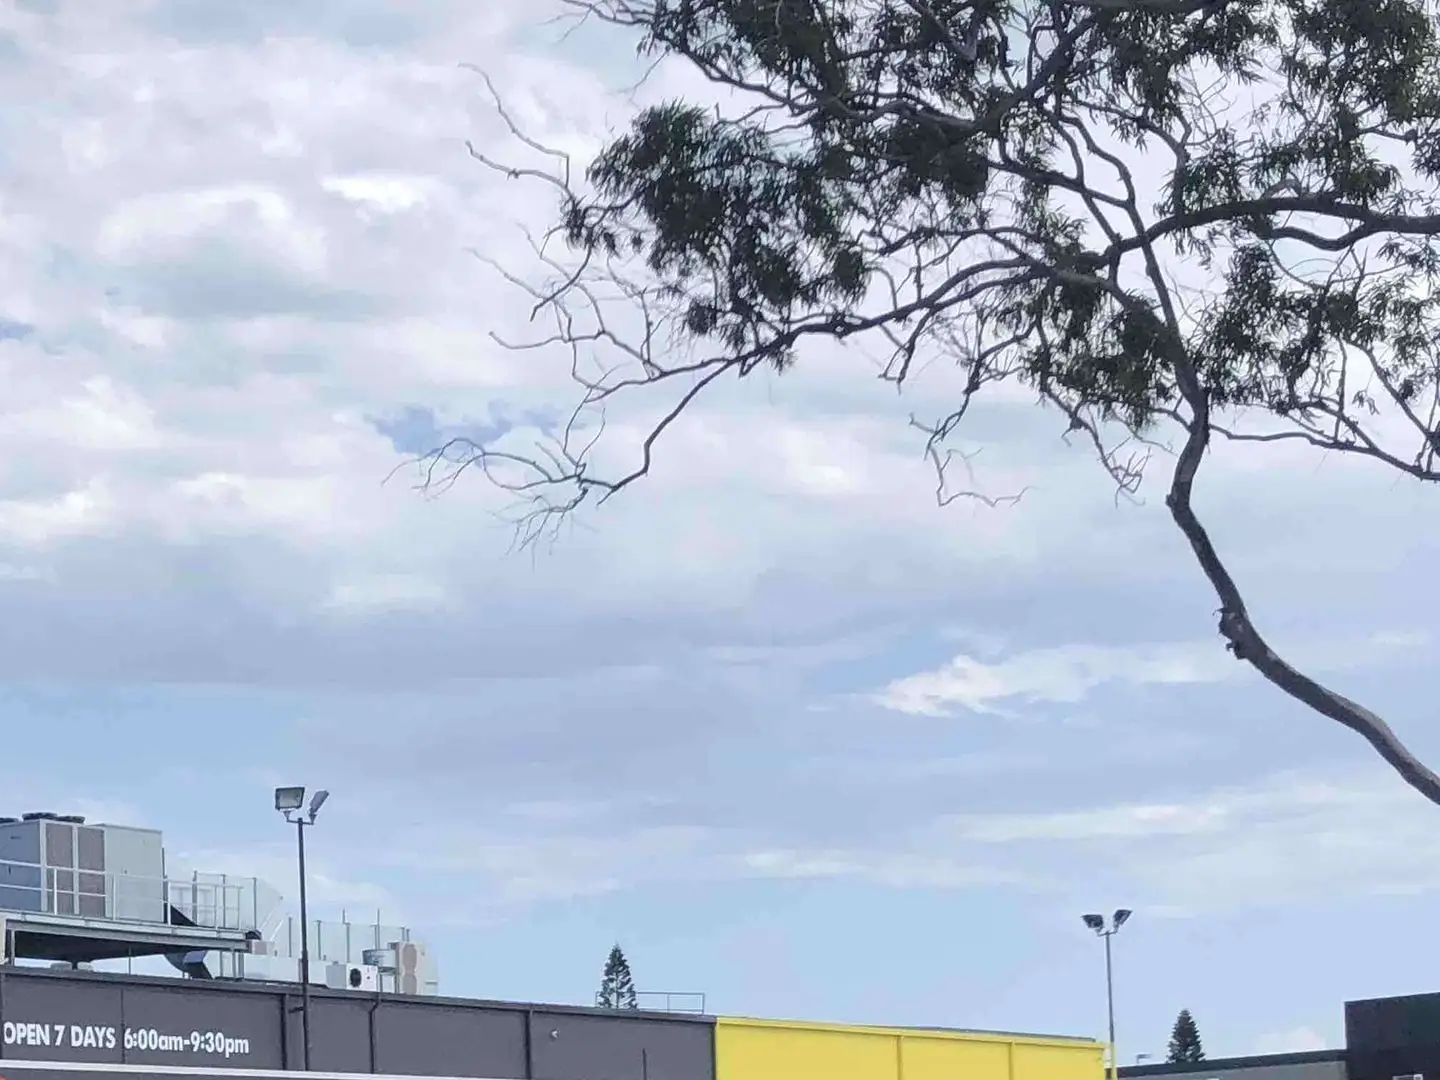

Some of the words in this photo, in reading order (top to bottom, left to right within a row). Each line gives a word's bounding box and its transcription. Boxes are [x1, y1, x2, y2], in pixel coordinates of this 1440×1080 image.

[3, 1022, 49, 1046] OPEN
[54, 1025, 66, 1047] 7
[70, 1026, 116, 1049] DAYS
